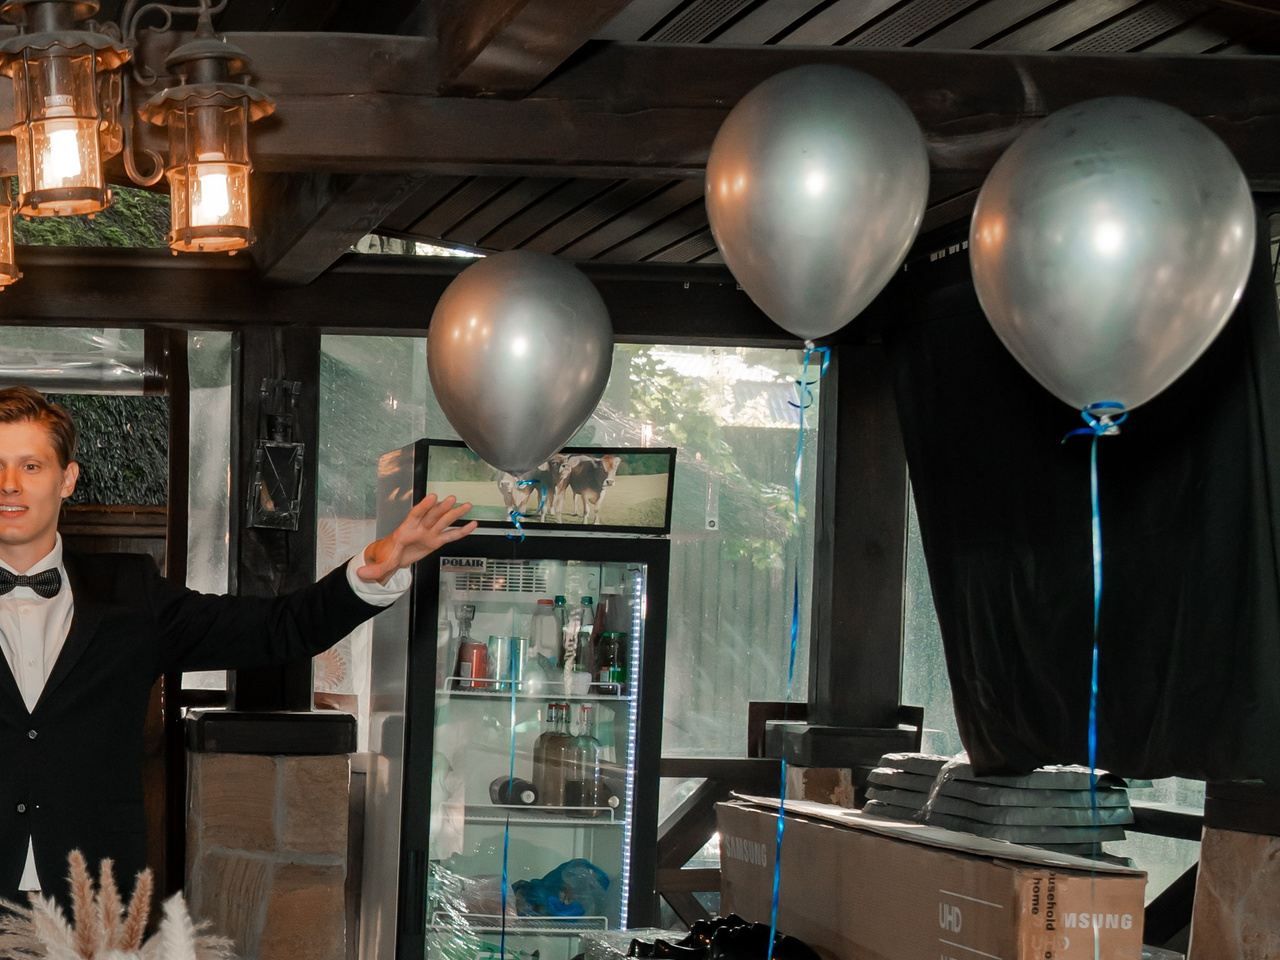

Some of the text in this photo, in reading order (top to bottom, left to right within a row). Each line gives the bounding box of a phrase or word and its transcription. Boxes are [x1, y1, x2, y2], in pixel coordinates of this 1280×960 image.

[442, 558, 484, 567] POLAIR
[724, 833, 767, 867] SAMSUNG
[1031, 877, 1042, 915] home
[938, 902, 962, 933] UHD
[1063, 912, 1133, 929] MSUNG
